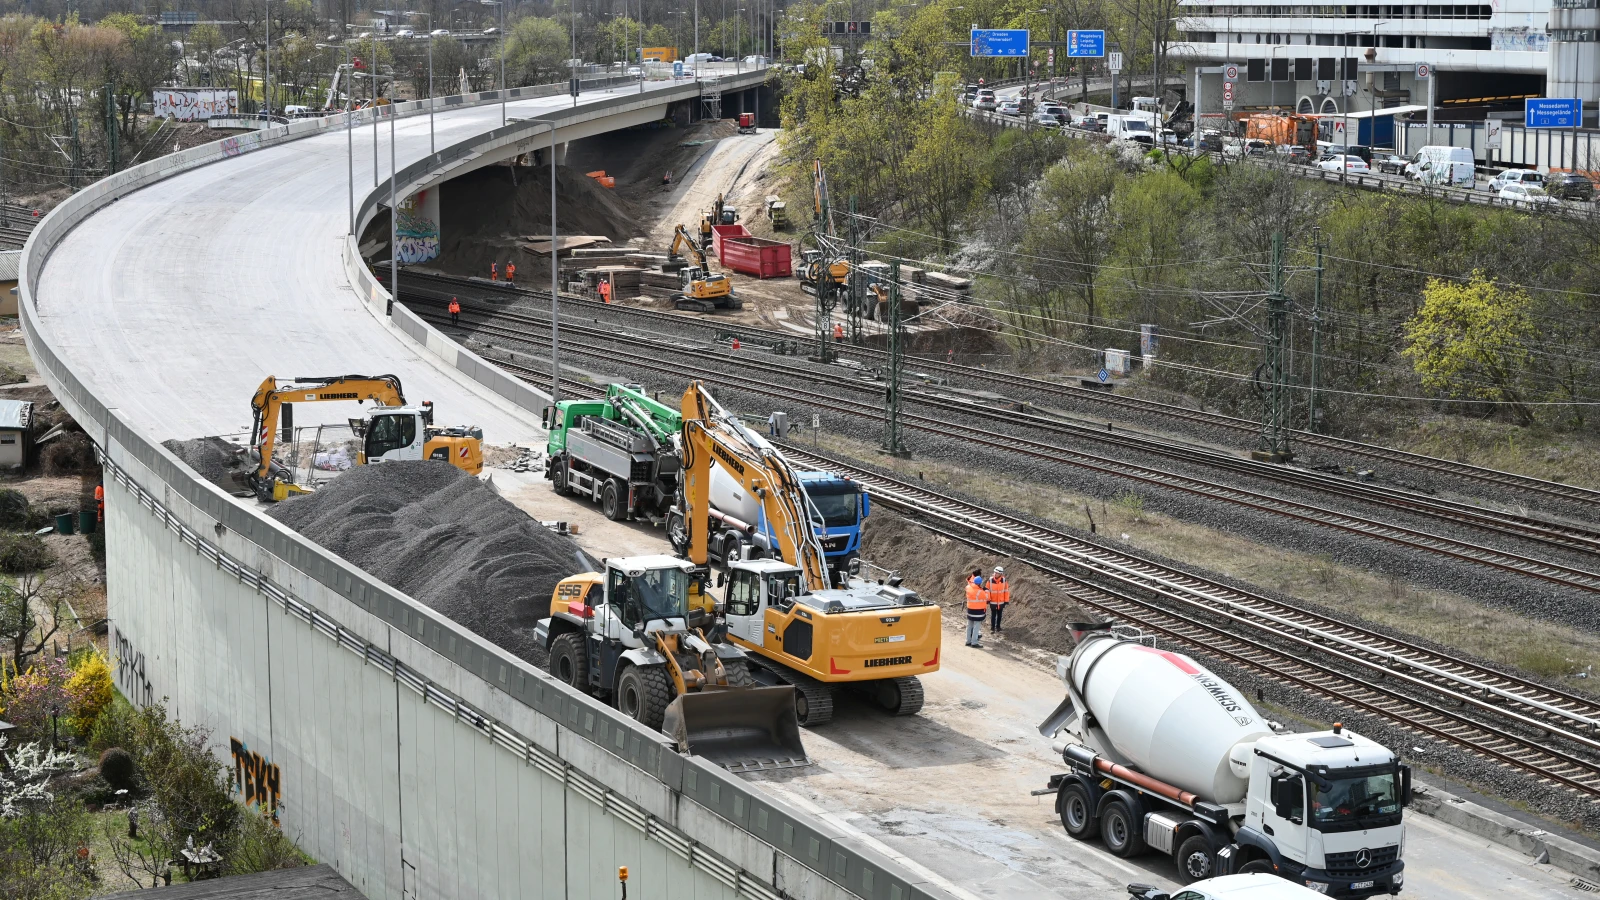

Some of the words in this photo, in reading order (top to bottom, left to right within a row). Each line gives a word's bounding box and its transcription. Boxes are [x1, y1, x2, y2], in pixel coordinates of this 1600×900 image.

[1536, 109, 1571, 117] Messegelände
[319, 392, 358, 400] LIEBHERR
[712, 442, 745, 477] LIEBHERR
[557, 584, 582, 597] 556
[864, 655, 913, 668] LIEBHERR
[1194, 673, 1242, 712] SCHWENK
